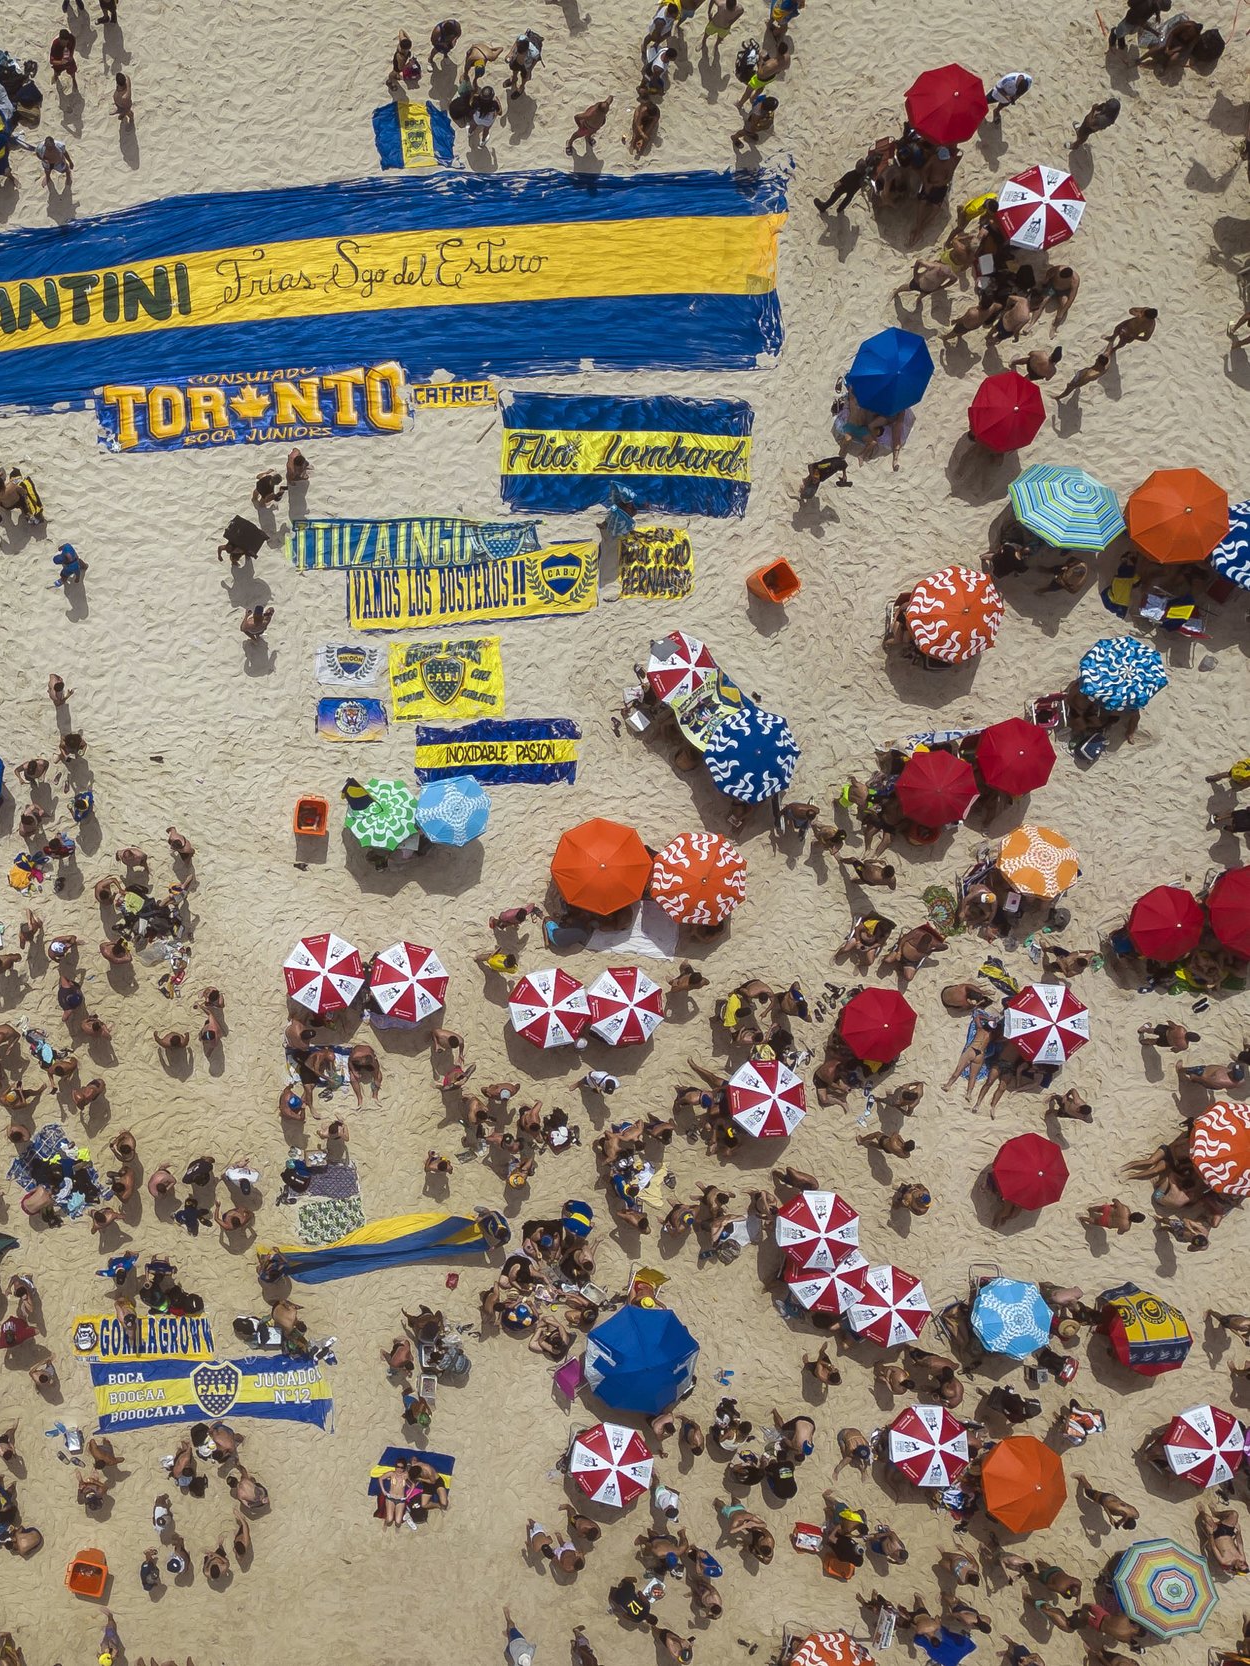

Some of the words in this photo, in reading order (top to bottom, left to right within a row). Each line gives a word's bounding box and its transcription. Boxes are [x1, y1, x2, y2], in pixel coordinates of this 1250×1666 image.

[393, 253, 433, 286] del
[436, 237, 548, 289] Estero
[187, 367, 317, 385] CONSULADO
[413, 384, 496, 405] CATRIEL
[102, 360, 406, 449] TORNTO
[184, 428, 237, 446] BOCA
[247, 426, 333, 442] JUNIORS
[546, 566, 577, 578] CABJ
[353, 570, 402, 620] VAMOS
[407, 571, 432, 616] LOS
[427, 672, 459, 682] CABJ
[445, 744, 509, 764] INOXIDABLE
[515, 743, 556, 762] PASION
[108, 1373, 145, 1385] BOCA
[109, 1389, 166, 1404] BOOCAA
[197, 1383, 235, 1396] CABJ
[110, 1405, 186, 1423] BOOOCAAA
[627, 1600, 644, 1615] 12
